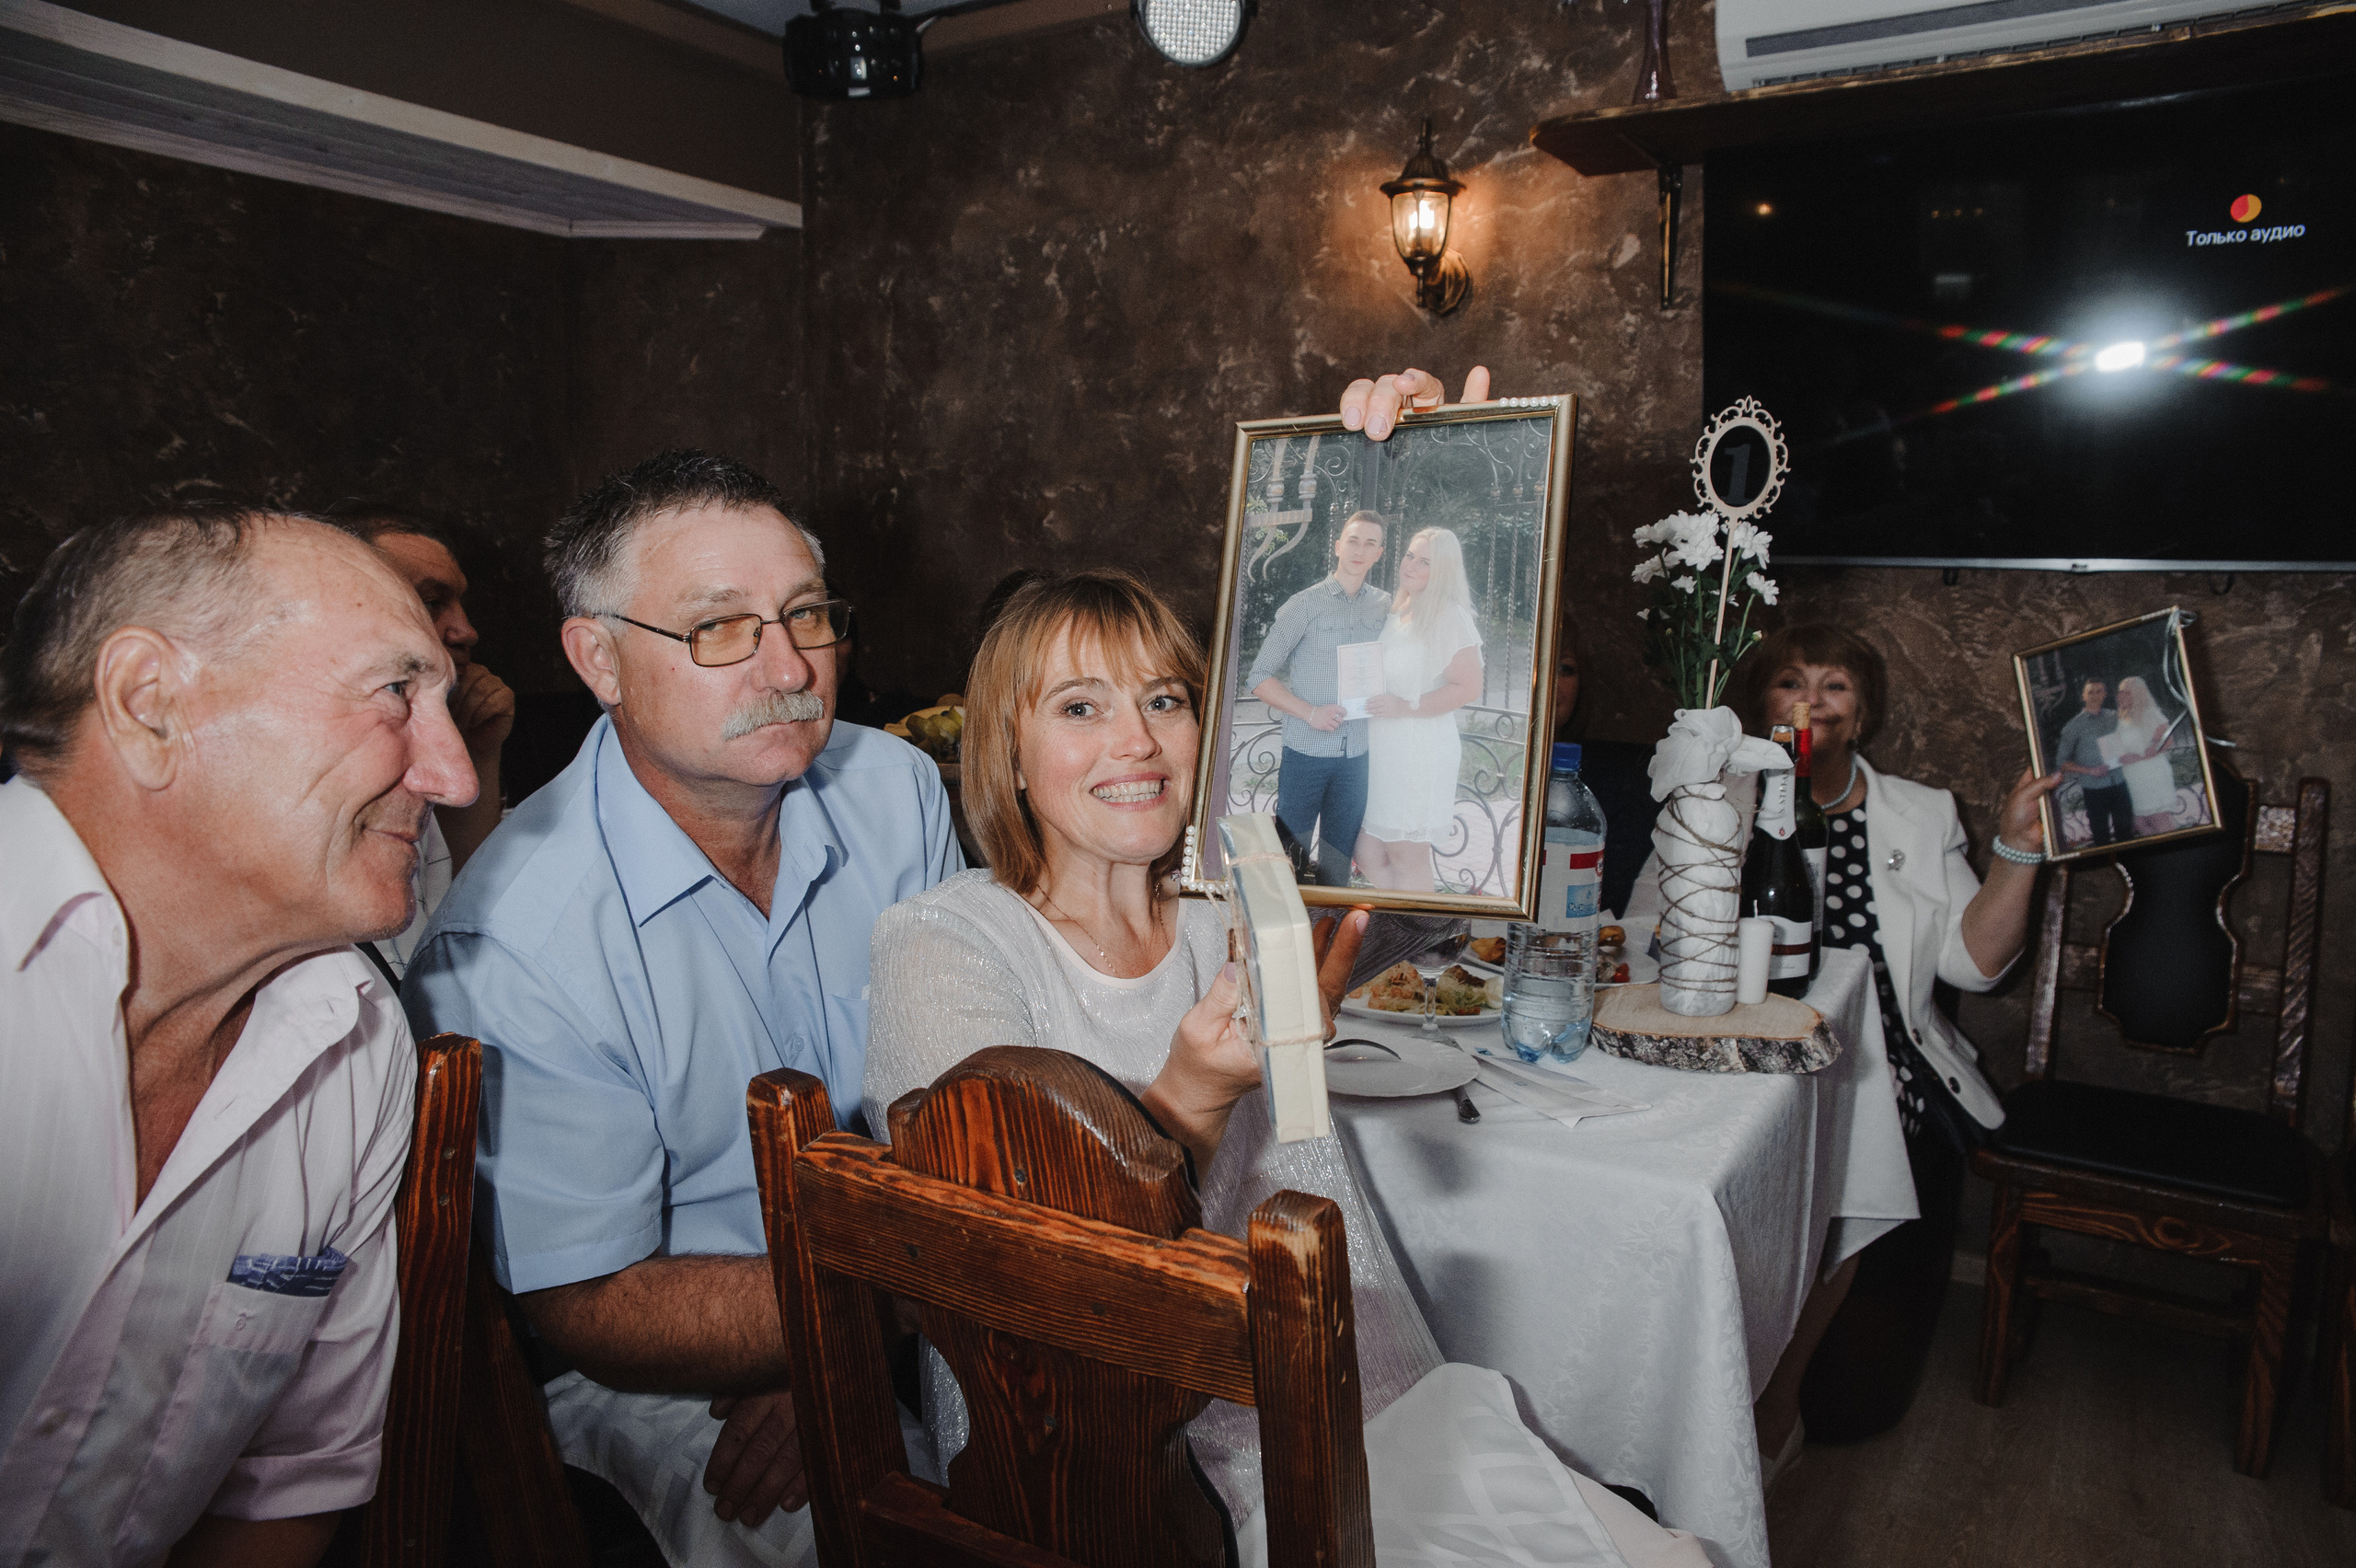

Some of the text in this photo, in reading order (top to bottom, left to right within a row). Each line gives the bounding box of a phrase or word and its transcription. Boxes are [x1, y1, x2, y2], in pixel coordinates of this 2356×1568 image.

[2185, 224, 2306, 247] Только аудио
[1720, 443, 1754, 505] 1
